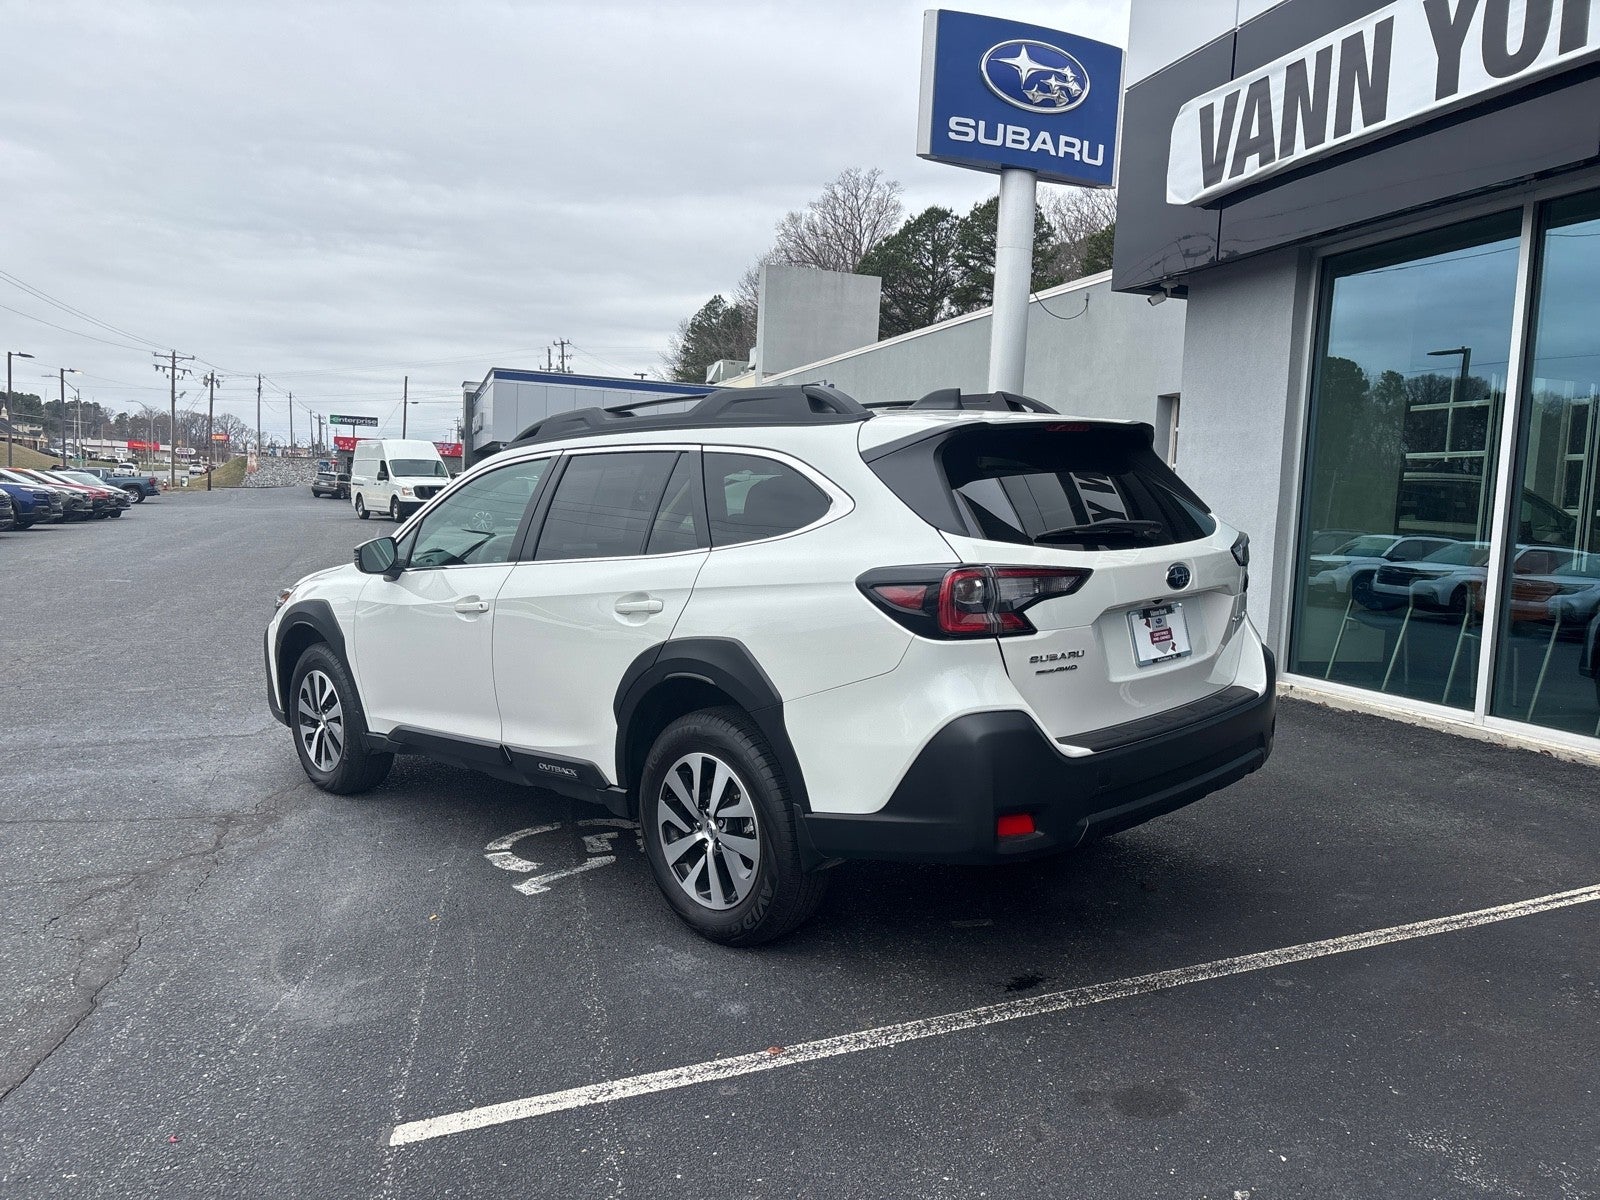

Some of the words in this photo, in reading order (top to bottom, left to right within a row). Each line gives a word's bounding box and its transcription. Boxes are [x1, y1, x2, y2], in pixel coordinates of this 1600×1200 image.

[1199, 16, 1395, 189] VANN
[948, 116, 1104, 167] SUBARU
[331, 416, 377, 425] enterprise
[1029, 650, 1085, 664] SUBARU
[1053, 664, 1078, 673] AWD
[538, 762, 577, 777] OUTBACK
